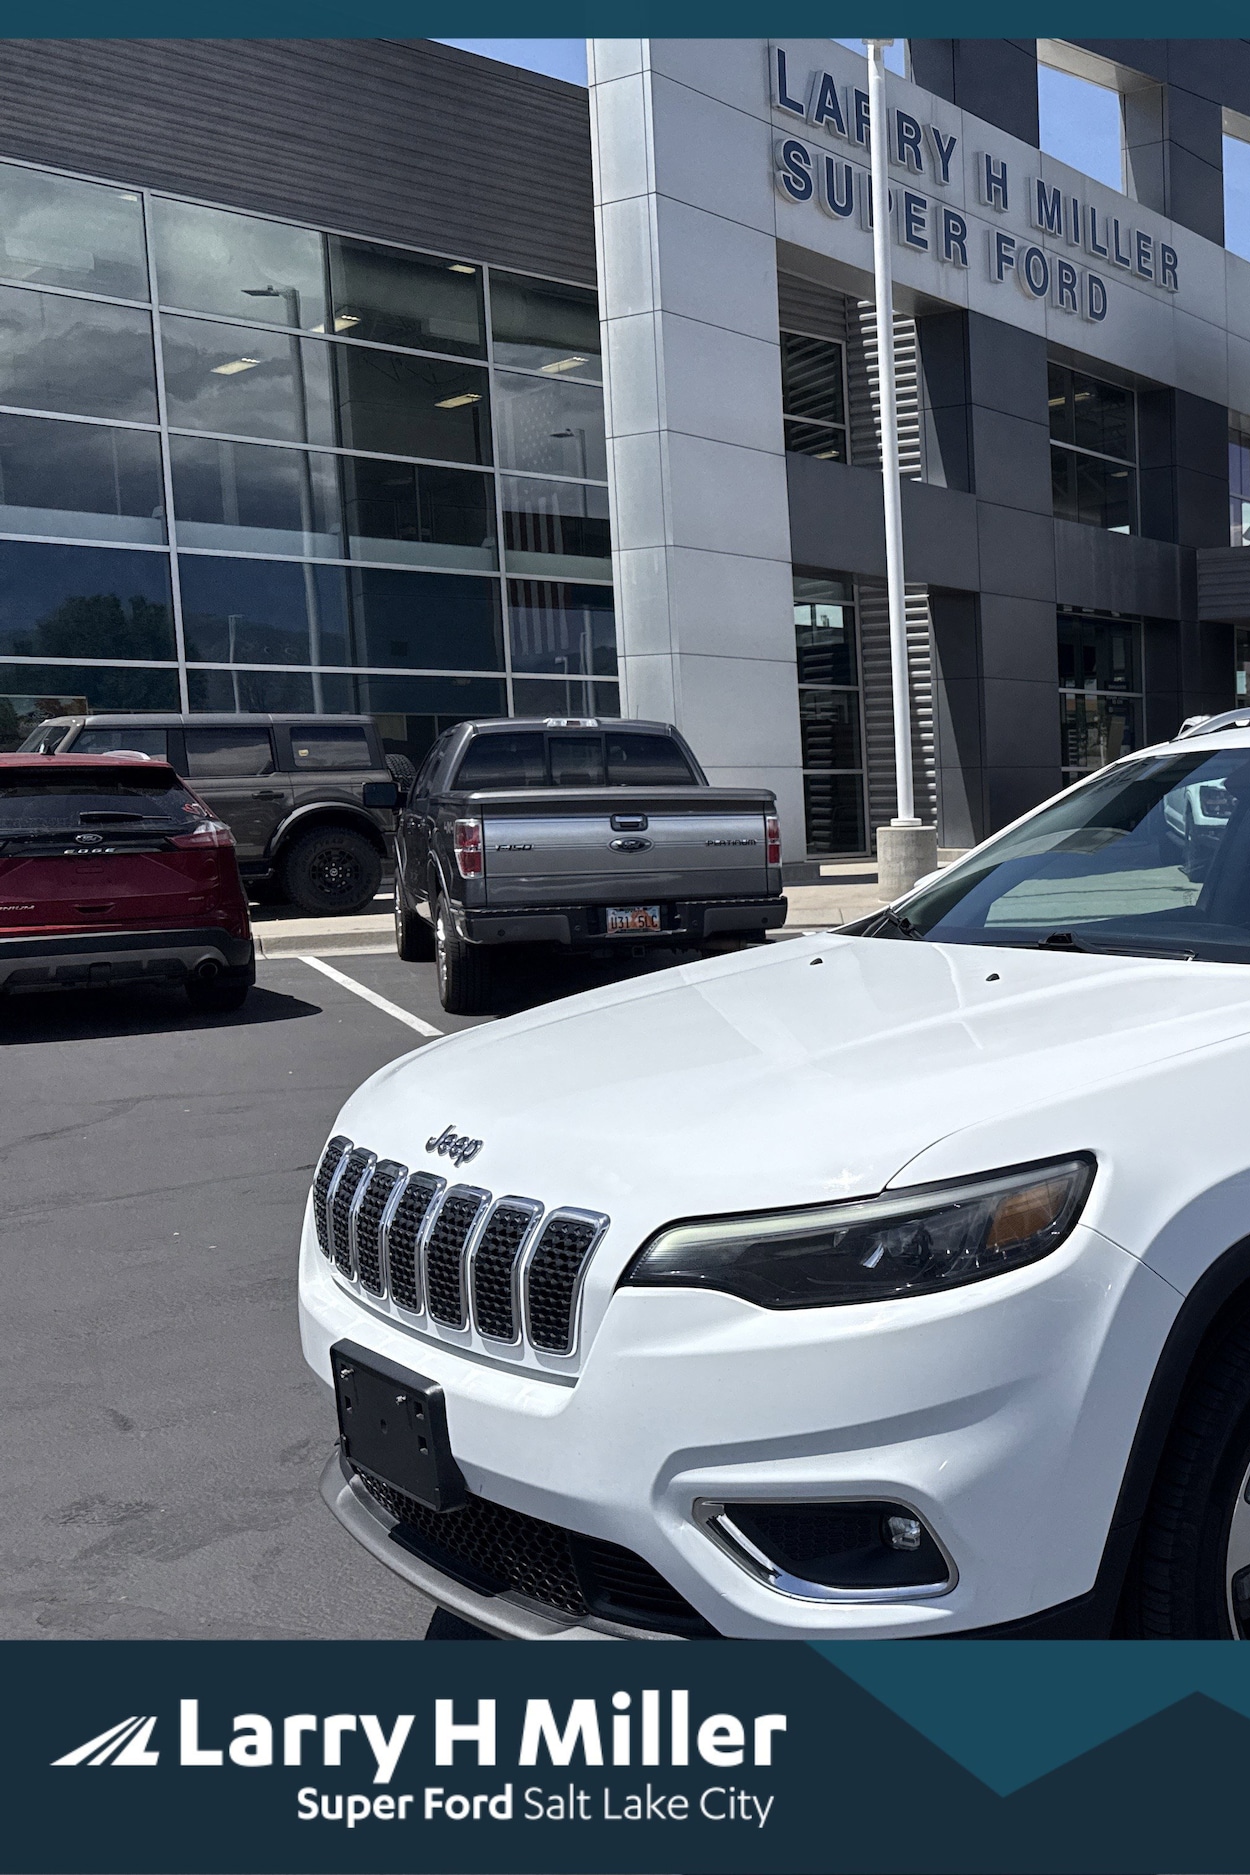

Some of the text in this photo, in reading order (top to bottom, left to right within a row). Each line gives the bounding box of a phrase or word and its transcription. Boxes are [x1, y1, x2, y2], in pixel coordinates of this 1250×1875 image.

[979, 151, 1010, 212] H
[1031, 176, 1181, 293] MILLER
[990, 229, 1109, 323] FORD
[425, 1124, 484, 1168] Jeep
